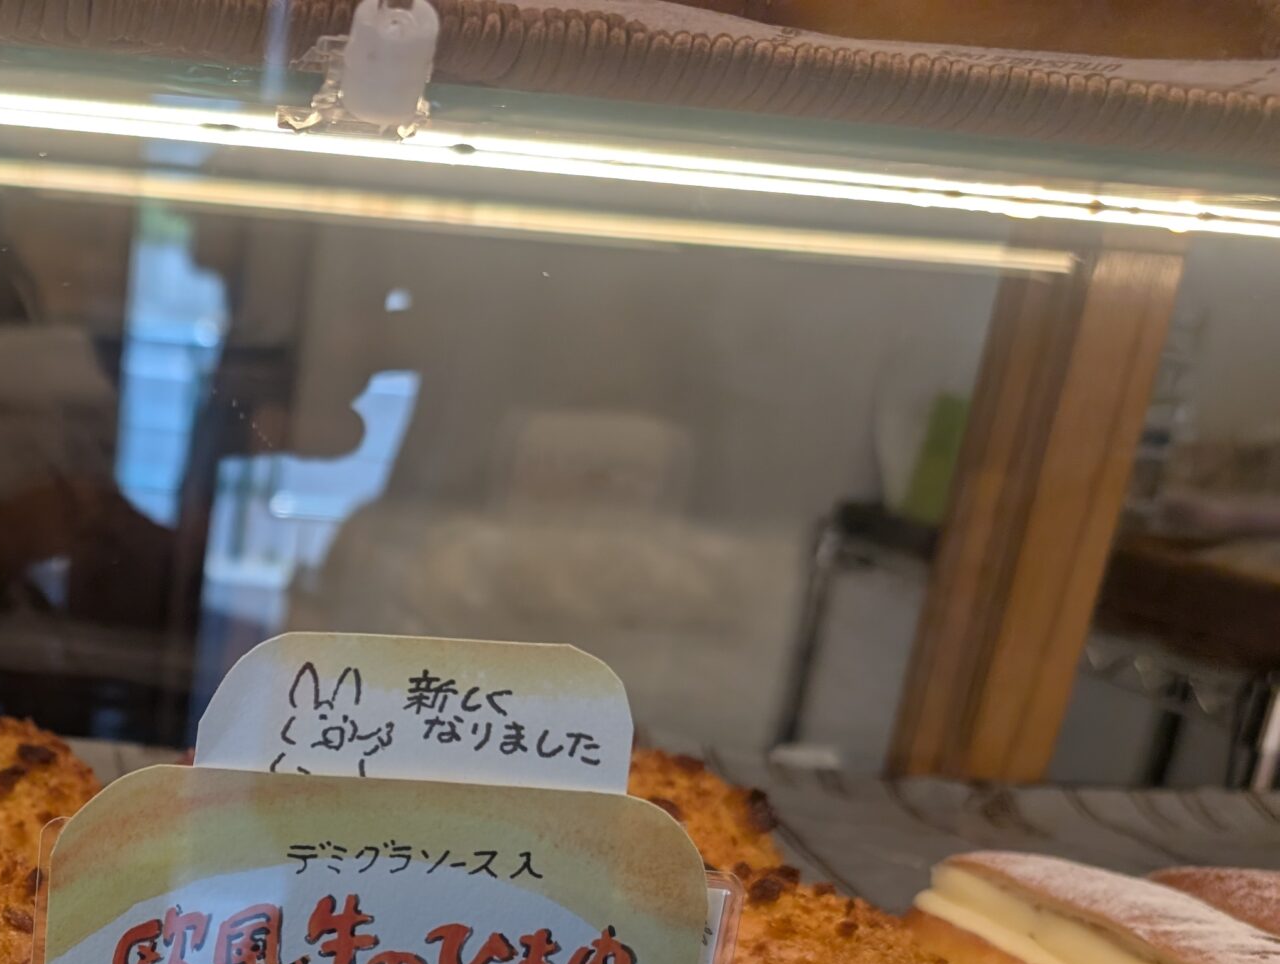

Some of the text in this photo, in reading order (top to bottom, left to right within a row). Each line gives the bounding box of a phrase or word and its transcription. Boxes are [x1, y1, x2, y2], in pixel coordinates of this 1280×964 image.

[404, 669, 513, 715] 新しく
[422, 715, 601, 767] なりました
[286, 841, 544, 881] デミグラソース入
